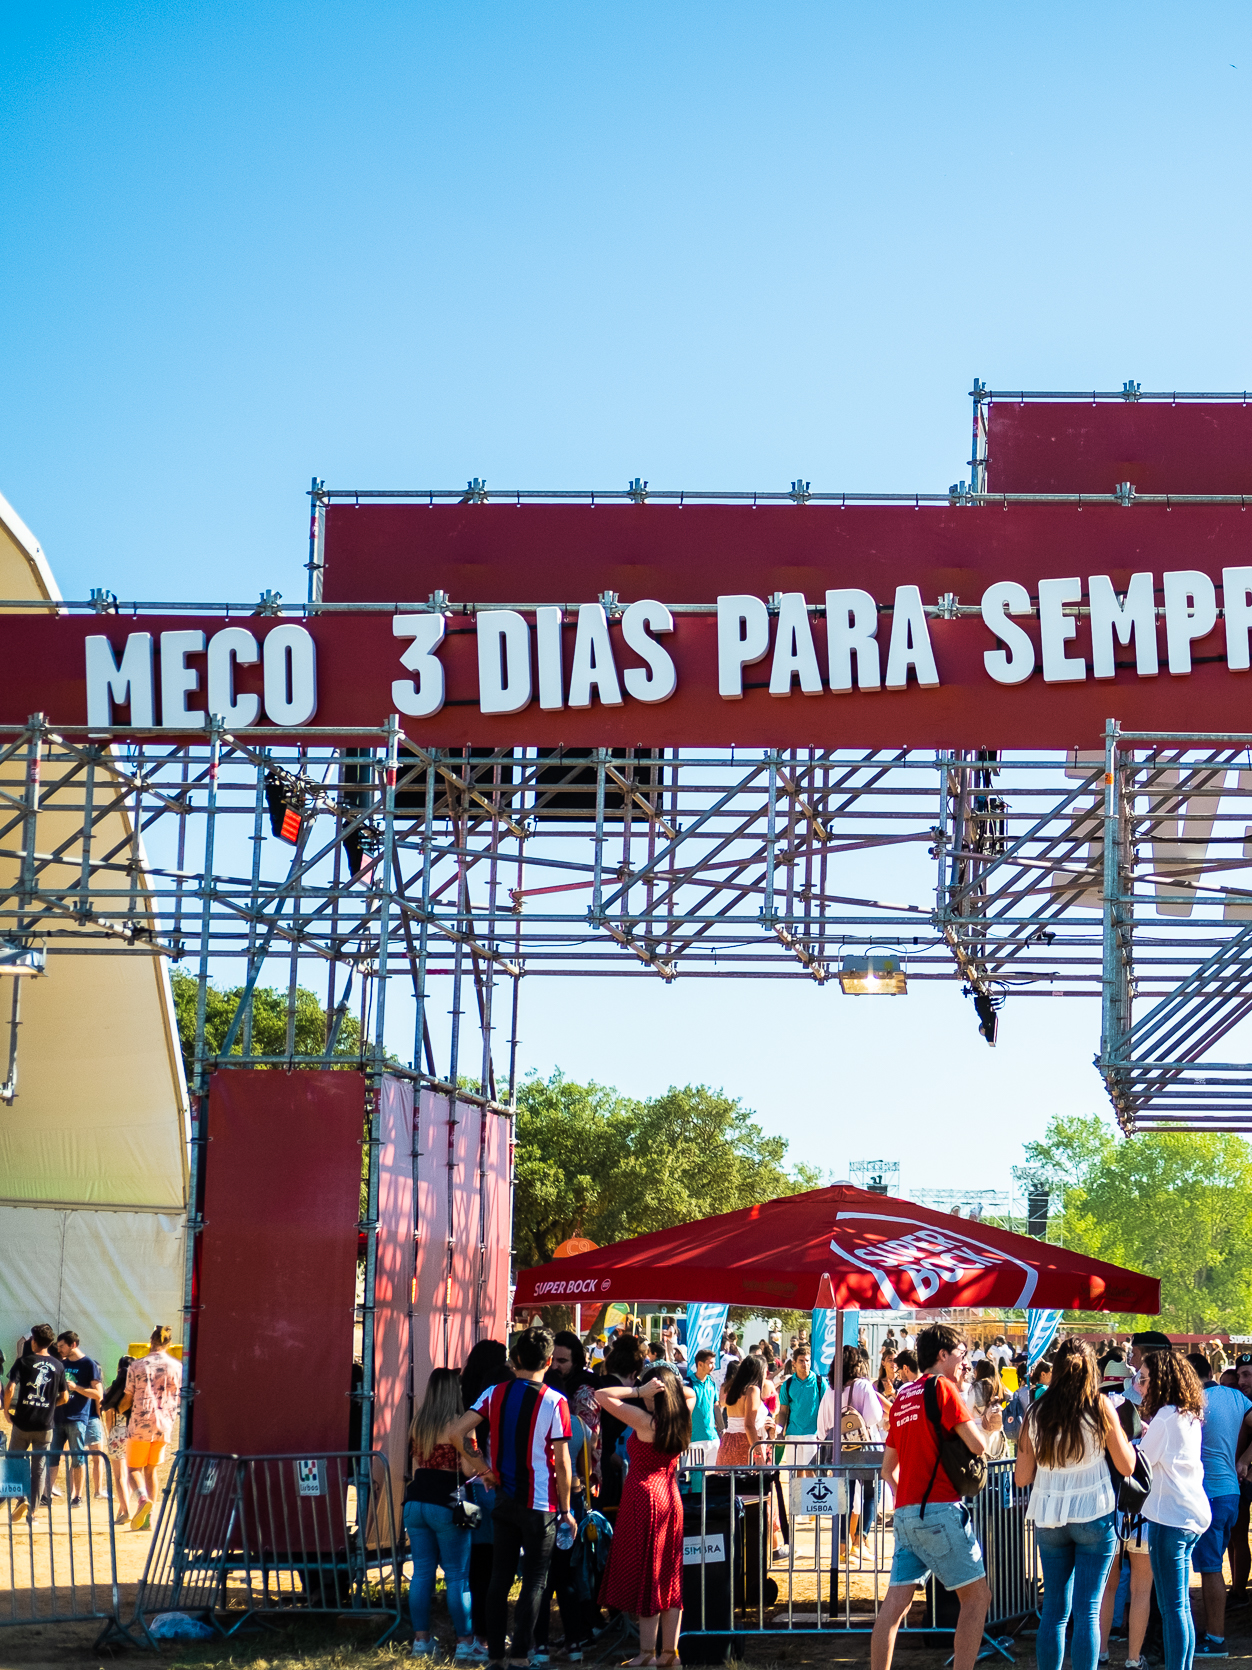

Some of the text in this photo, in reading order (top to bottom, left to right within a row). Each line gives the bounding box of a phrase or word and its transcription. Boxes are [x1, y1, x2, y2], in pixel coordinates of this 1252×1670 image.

[85, 624, 317, 739] MECO
[391, 613, 447, 719] 3
[477, 599, 679, 715] DIAS
[717, 584, 941, 700] PARA
[854, 1229, 963, 1267] SUPER
[534, 1281, 565, 1296] SUPER
[566, 1279, 598, 1294] BOCK
[900, 1246, 1004, 1302] BOCK
